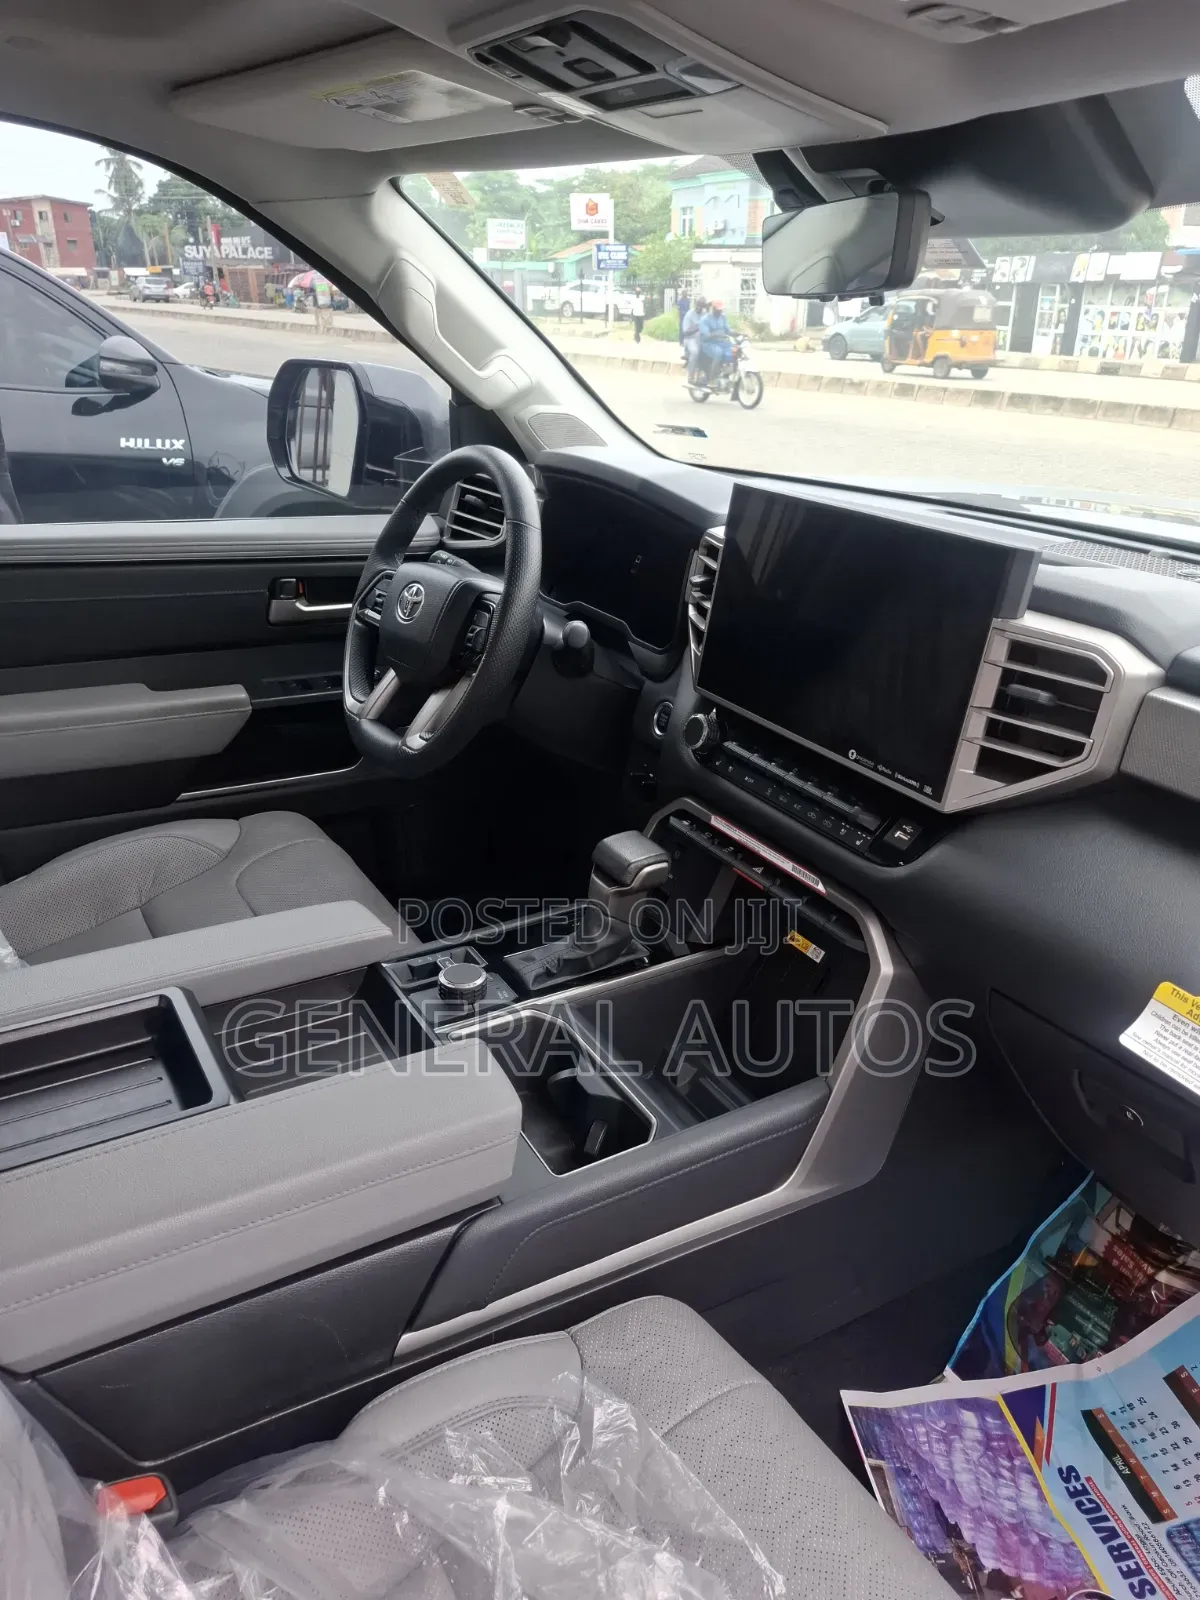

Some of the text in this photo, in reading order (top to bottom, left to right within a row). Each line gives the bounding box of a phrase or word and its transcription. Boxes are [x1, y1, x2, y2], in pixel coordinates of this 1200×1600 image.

[220, 245, 274, 260] PALACE
[120, 437, 185, 450] HILUX
[162, 457, 185, 467] V6
[1170, 988, 1188, 1002] This
[1150, 1010, 1171, 1026] Children
[1171, 1024, 1180, 1032] can
[1182, 1028, 1188, 1036] be
[1172, 1014, 1189, 1026] Even
[1159, 1024, 1168, 1032] The
[1169, 1030, 1180, 1040] back
[1153, 1038, 1170, 1050] Always
[1154, 1030, 1168, 1040] Never
[1169, 1039, 1177, 1048] put
[1112, 1245, 1135, 1268] Sales
[1137, 1396, 1147, 1406] 25
[1148, 1411, 1159, 1420] 24
[1137, 1418, 1147, 1426] 17
[1171, 1420, 1181, 1430] 30
[1159, 1426, 1169, 1435] 23
[1148, 1432, 1158, 1440] 16
[1182, 1436, 1192, 1446] 29
[1159, 1447, 1168, 1455] 15
[1170, 1441, 1180, 1451] 22
[1112, 1454, 1131, 1475] APRIL
[1182, 1457, 1192, 1466] 21
[1170, 1463, 1181, 1471] 14
[1182, 1479, 1192, 1487] 13
[1057, 1464, 1157, 1600] SERVICES
[1130, 1539, 1147, 1564] GENERAL
